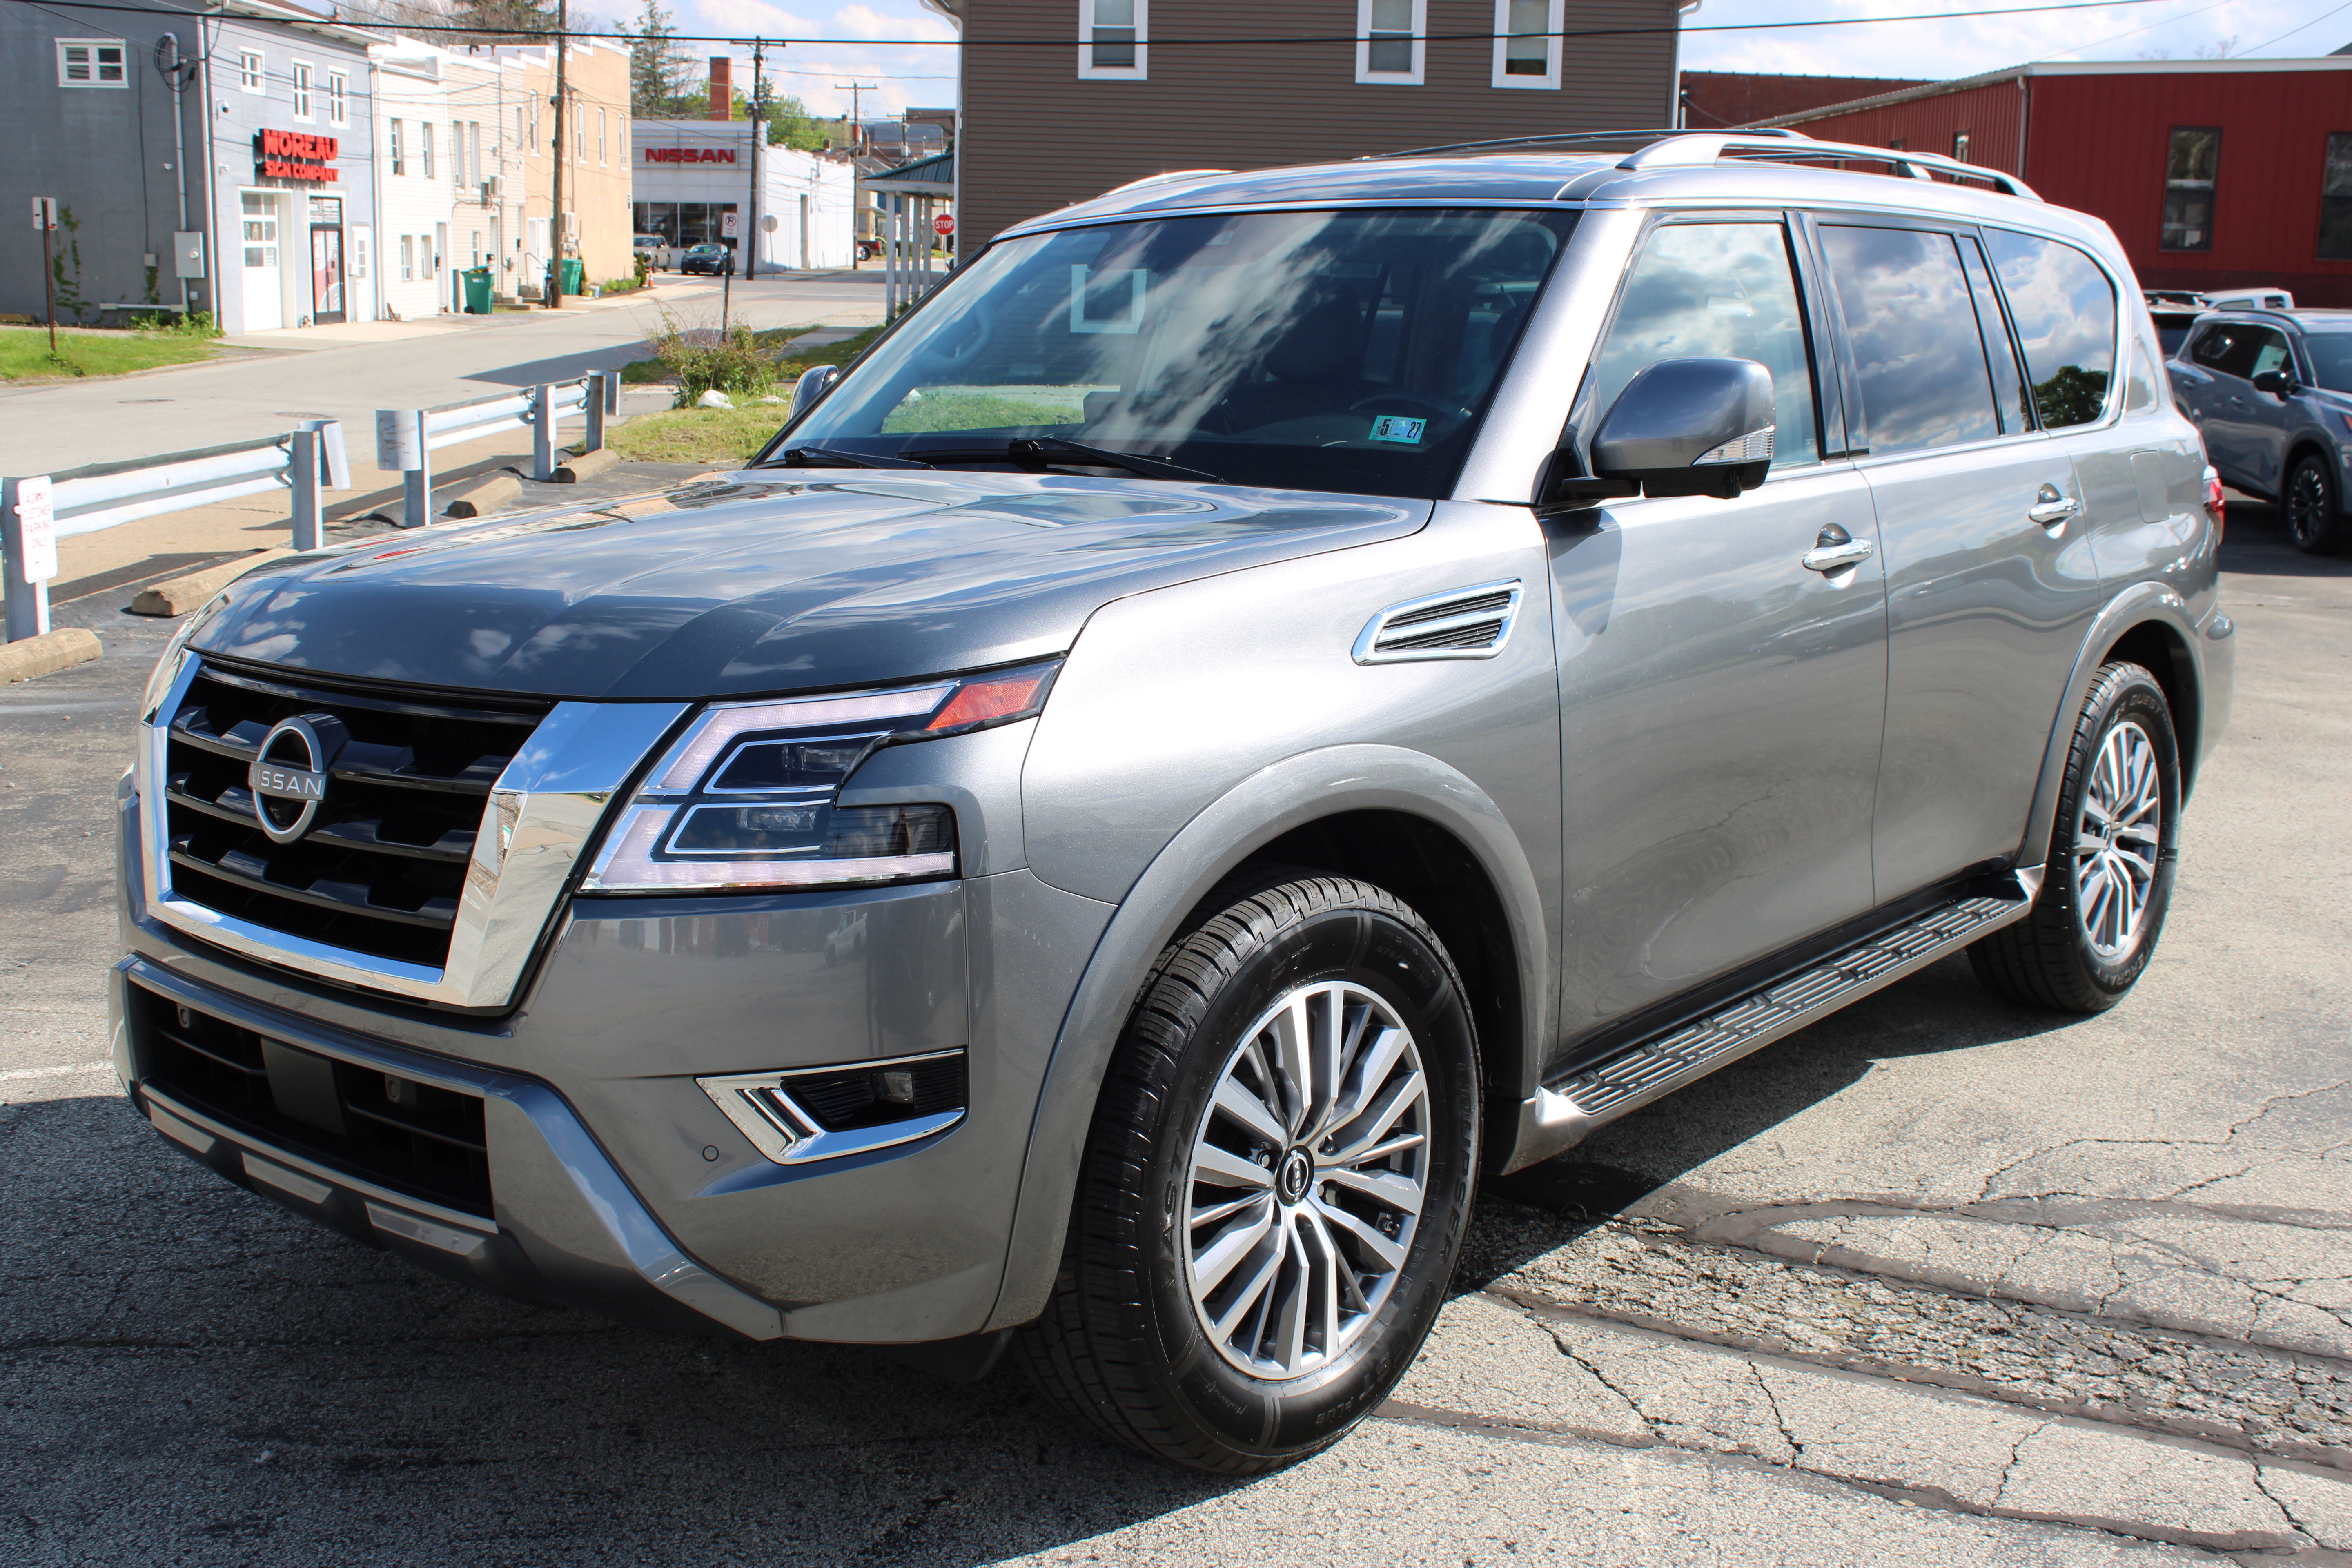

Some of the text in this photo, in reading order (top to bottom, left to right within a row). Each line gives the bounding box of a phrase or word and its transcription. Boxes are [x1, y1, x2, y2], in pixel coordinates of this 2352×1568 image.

[263, 128, 338, 160] MOREAU
[645, 148, 734, 163] NISSAN
[265, 160, 339, 182] SIGN COMPANY
[935, 220, 953, 229] STOP
[1380, 419, 1392, 436] 5
[1406, 421, 1422, 440] 27
[26, 490, 47, 504] AGWAY
[24, 504, 51, 521] CUSTOMER
[25, 519, 52, 535] PARKING
[32, 536, 47, 549] ONLY
[251, 766, 322, 795] NISSAN
[1438, 1063, 1471, 1265] COURSER
[1291, 1149, 1300, 1201] NISSAN
[1315, 1396, 1354, 1425] PLUS
